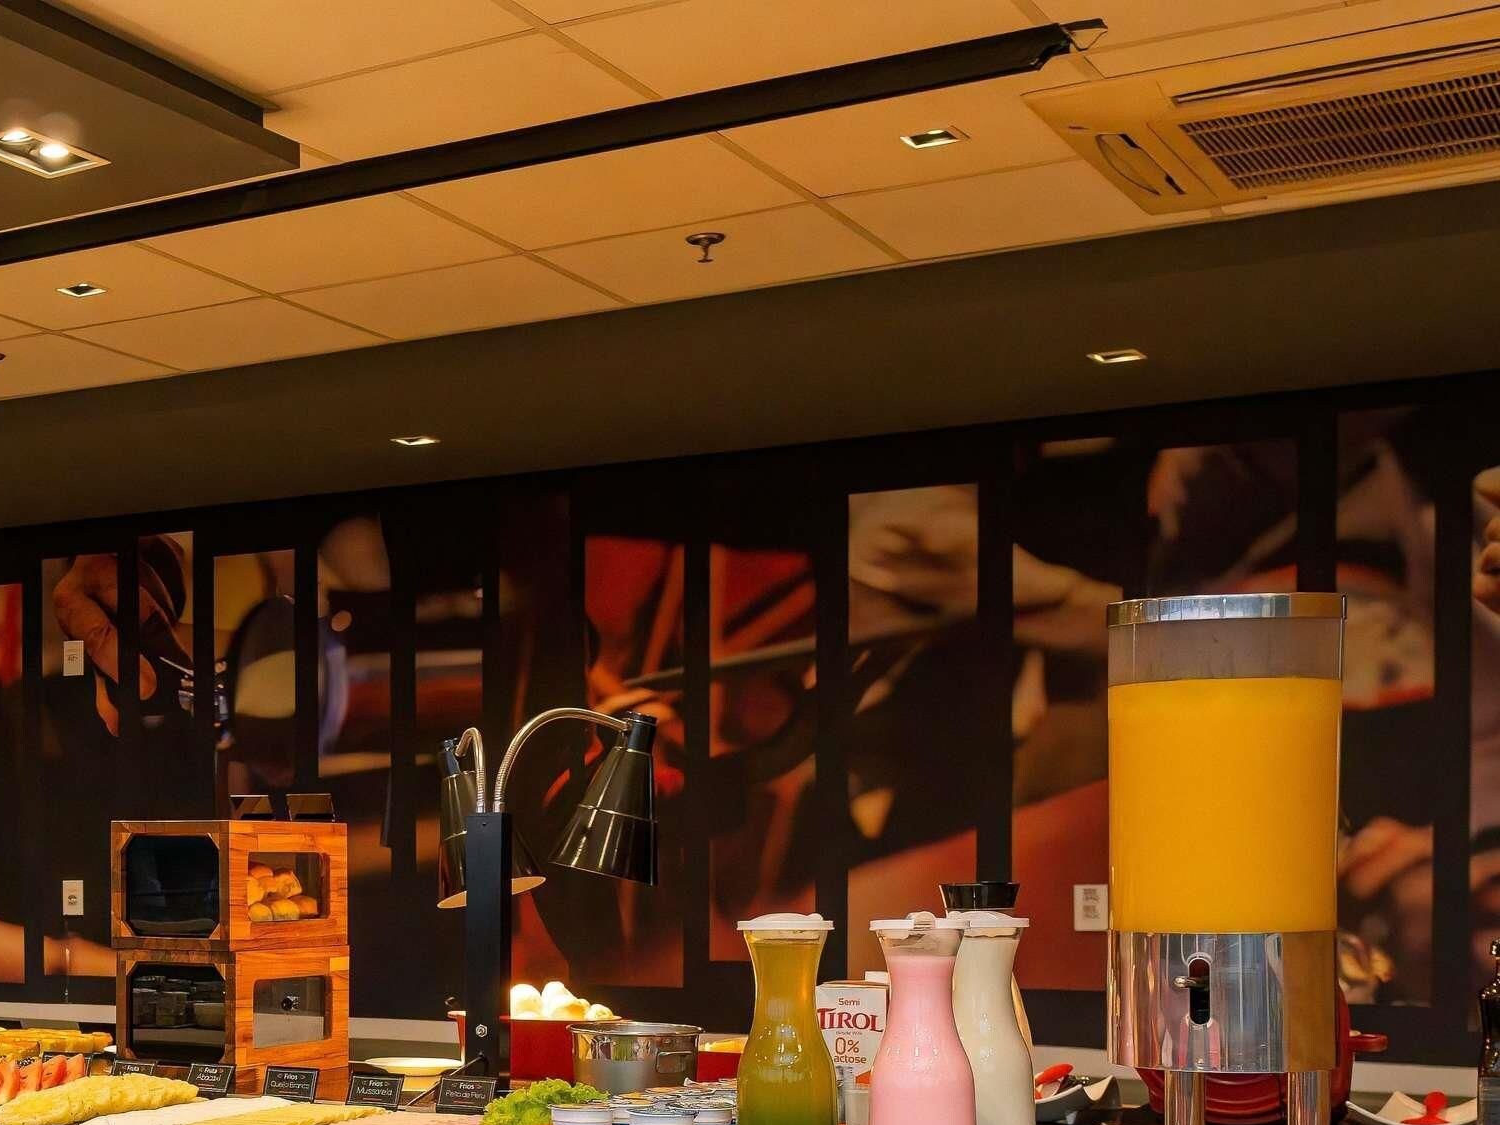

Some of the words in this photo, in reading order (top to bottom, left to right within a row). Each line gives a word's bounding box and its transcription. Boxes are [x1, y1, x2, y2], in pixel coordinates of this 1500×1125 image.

[838, 997, 861, 1006] Semi
[817, 1007, 884, 1032] TIROL
[836, 1037, 860, 1055] 0%
[833, 1055, 867, 1064] actose
[459, 1082, 475, 1090] Frios
